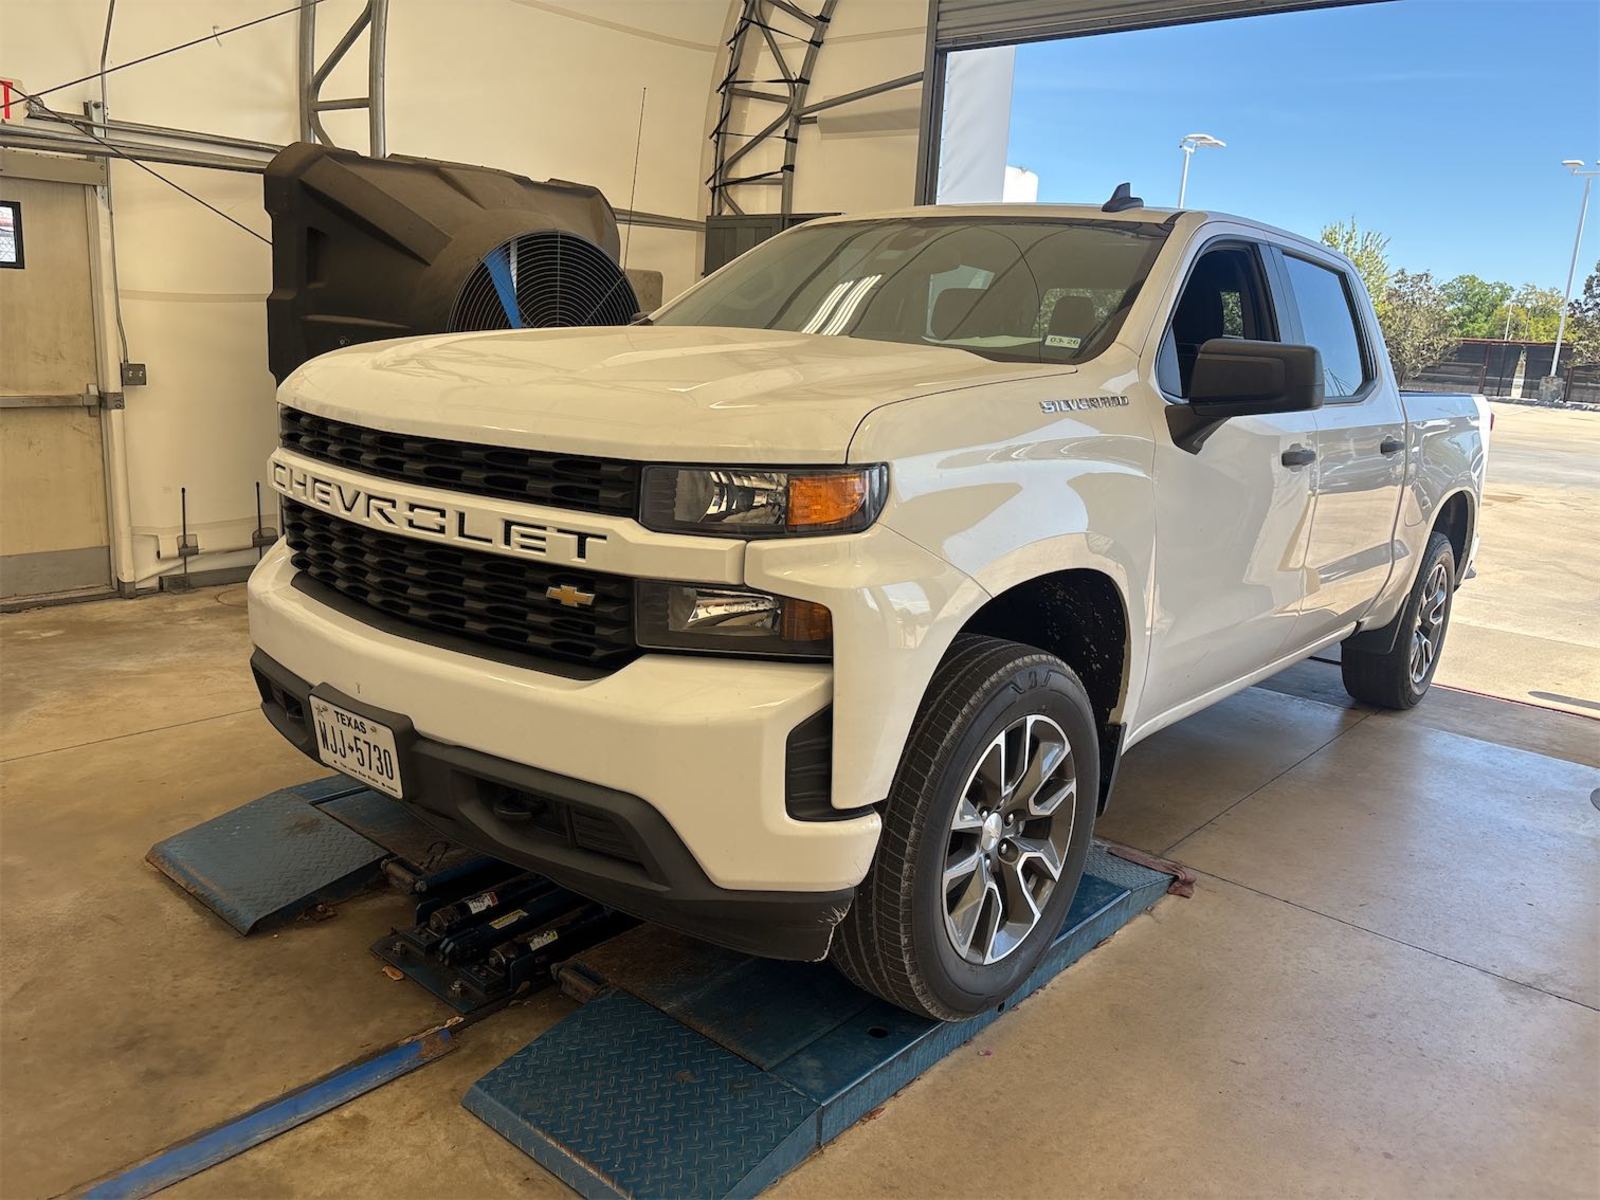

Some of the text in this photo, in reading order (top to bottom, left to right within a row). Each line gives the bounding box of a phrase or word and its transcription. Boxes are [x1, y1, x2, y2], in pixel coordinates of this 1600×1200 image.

[1040, 396, 1129, 413] SILVERADO
[272, 460, 608, 562] CHEVROLET
[334, 710, 367, 734] TEXAS
